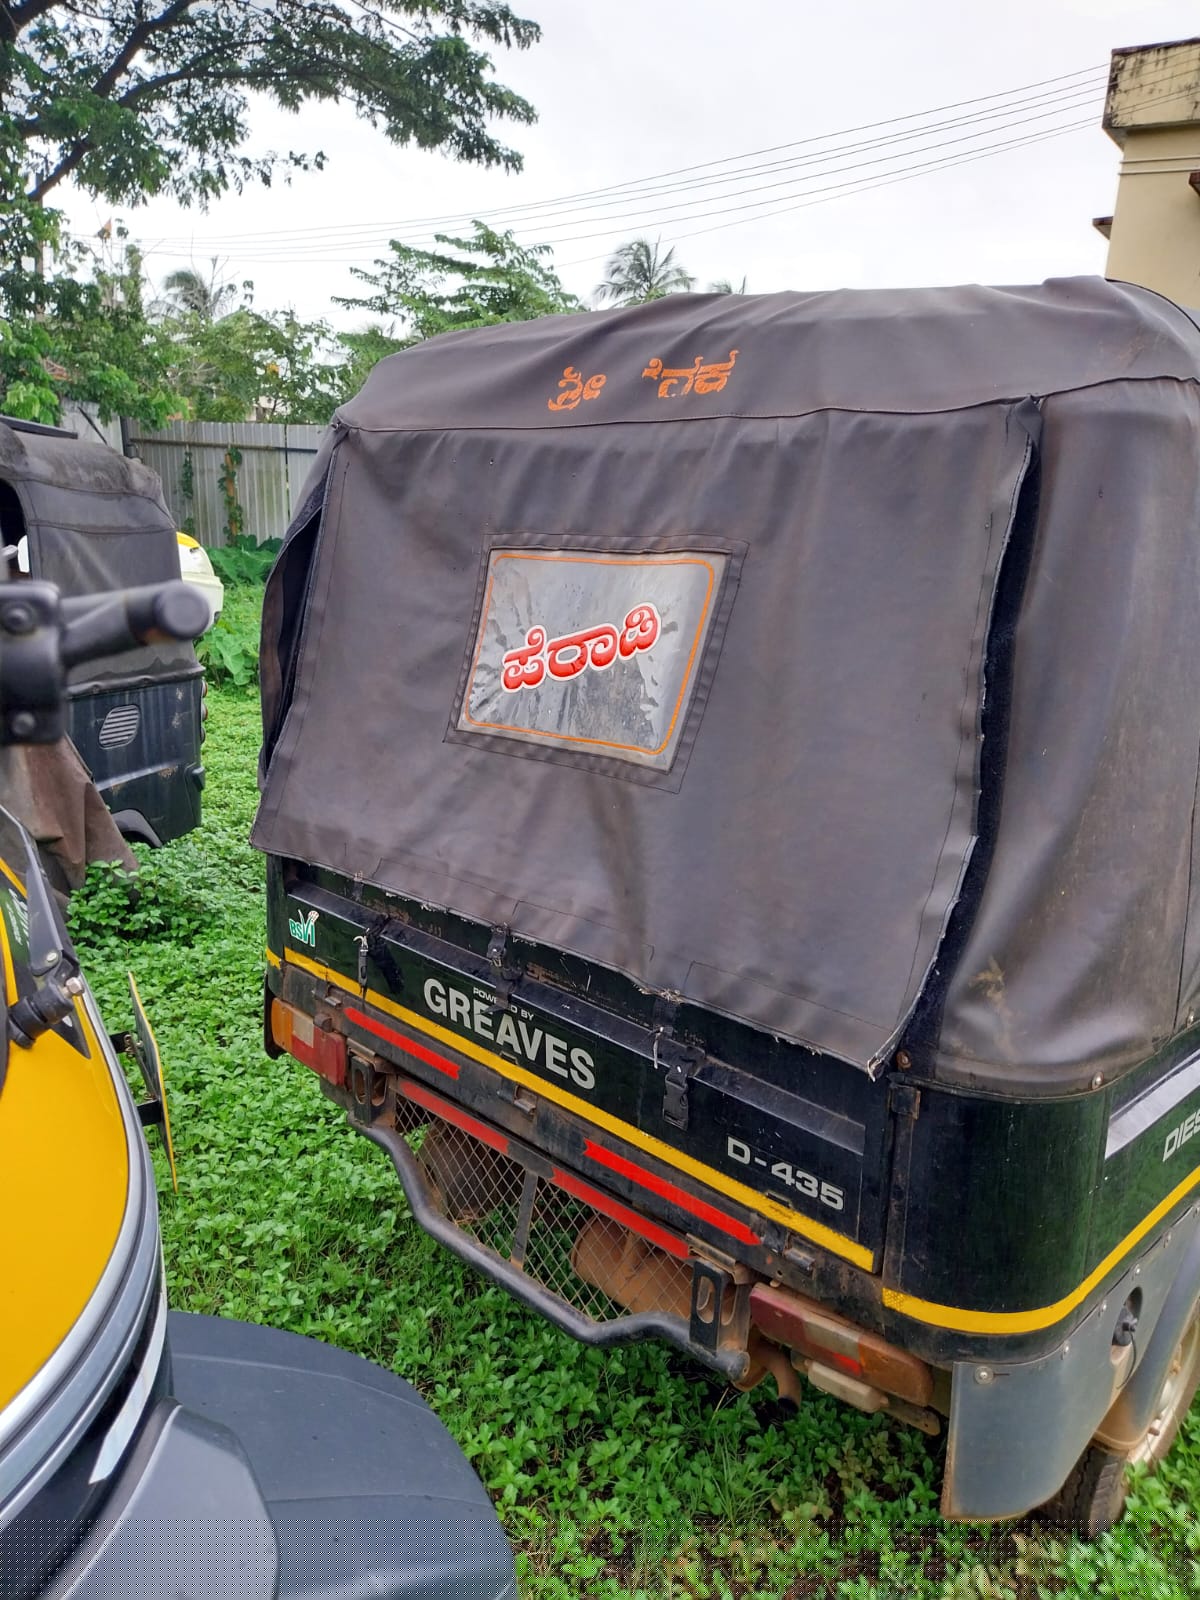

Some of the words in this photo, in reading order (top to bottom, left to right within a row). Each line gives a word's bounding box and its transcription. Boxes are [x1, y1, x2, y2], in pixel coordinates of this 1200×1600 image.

[548, 366, 607, 411] ಶ್ರೀ
[501, 602, 661, 693] ಪೆರಾಡಿ
[289, 909, 318, 947] BSVI
[423, 978, 596, 1090] GREAVES
[473, 987, 518, 1014] POWD
[520, 1009, 535, 1021] BY
[727, 1136, 844, 1211] D-435
